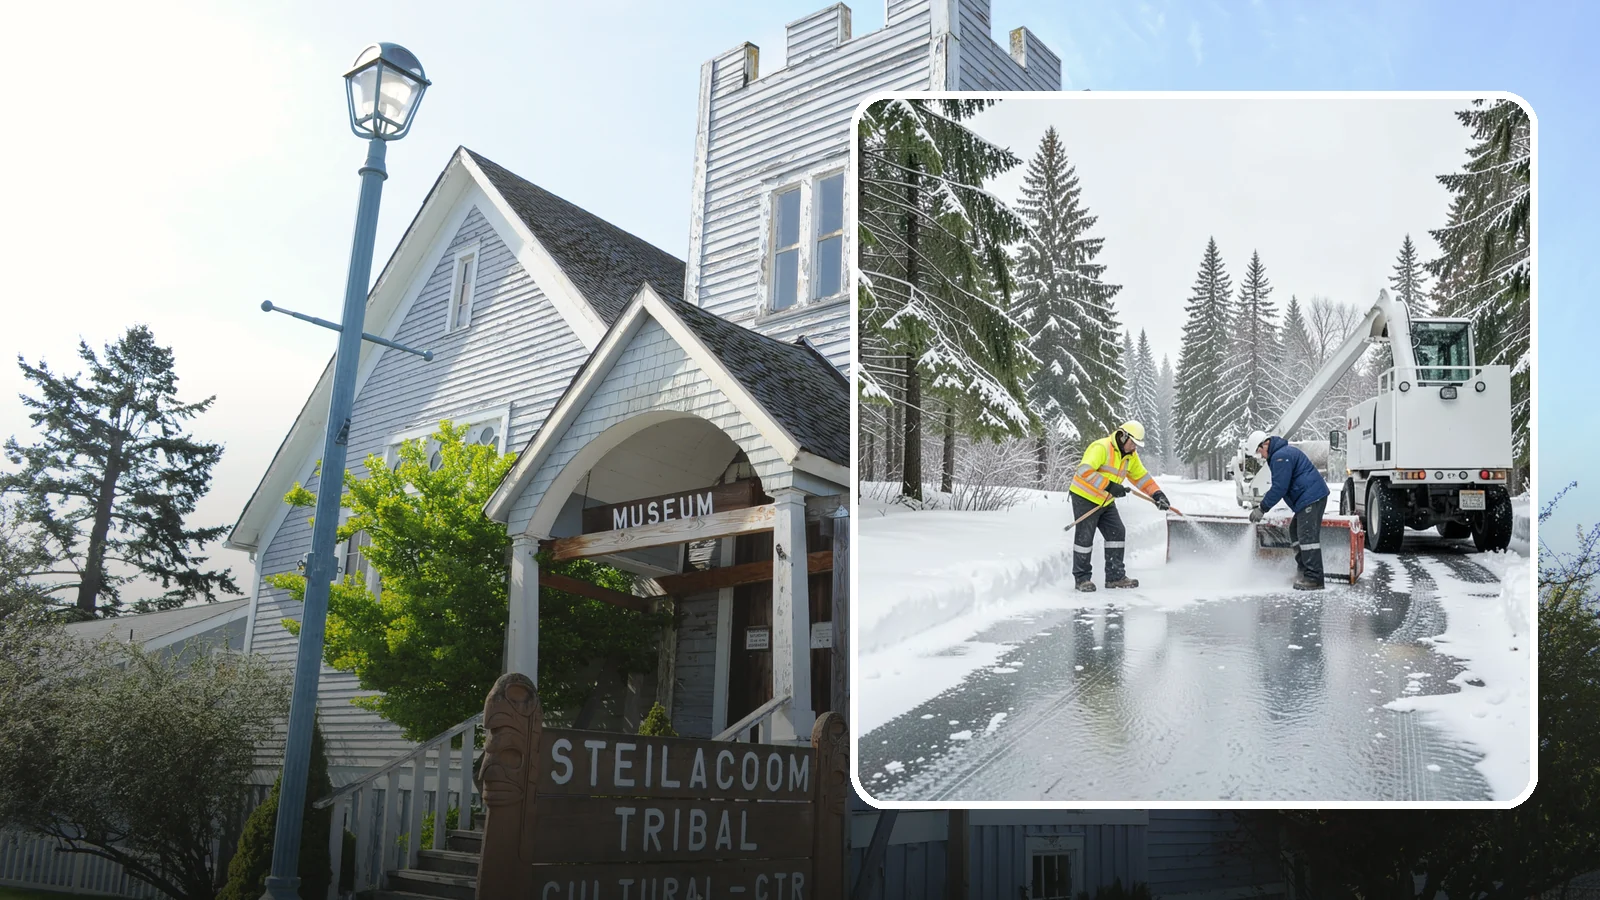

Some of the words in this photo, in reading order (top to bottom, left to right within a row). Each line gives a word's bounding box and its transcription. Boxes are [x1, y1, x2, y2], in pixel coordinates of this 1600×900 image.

[613, 491, 713, 530] MUSEUM
[551, 738, 810, 793] STEILACOOM
[615, 806, 758, 852] TRIBAL
